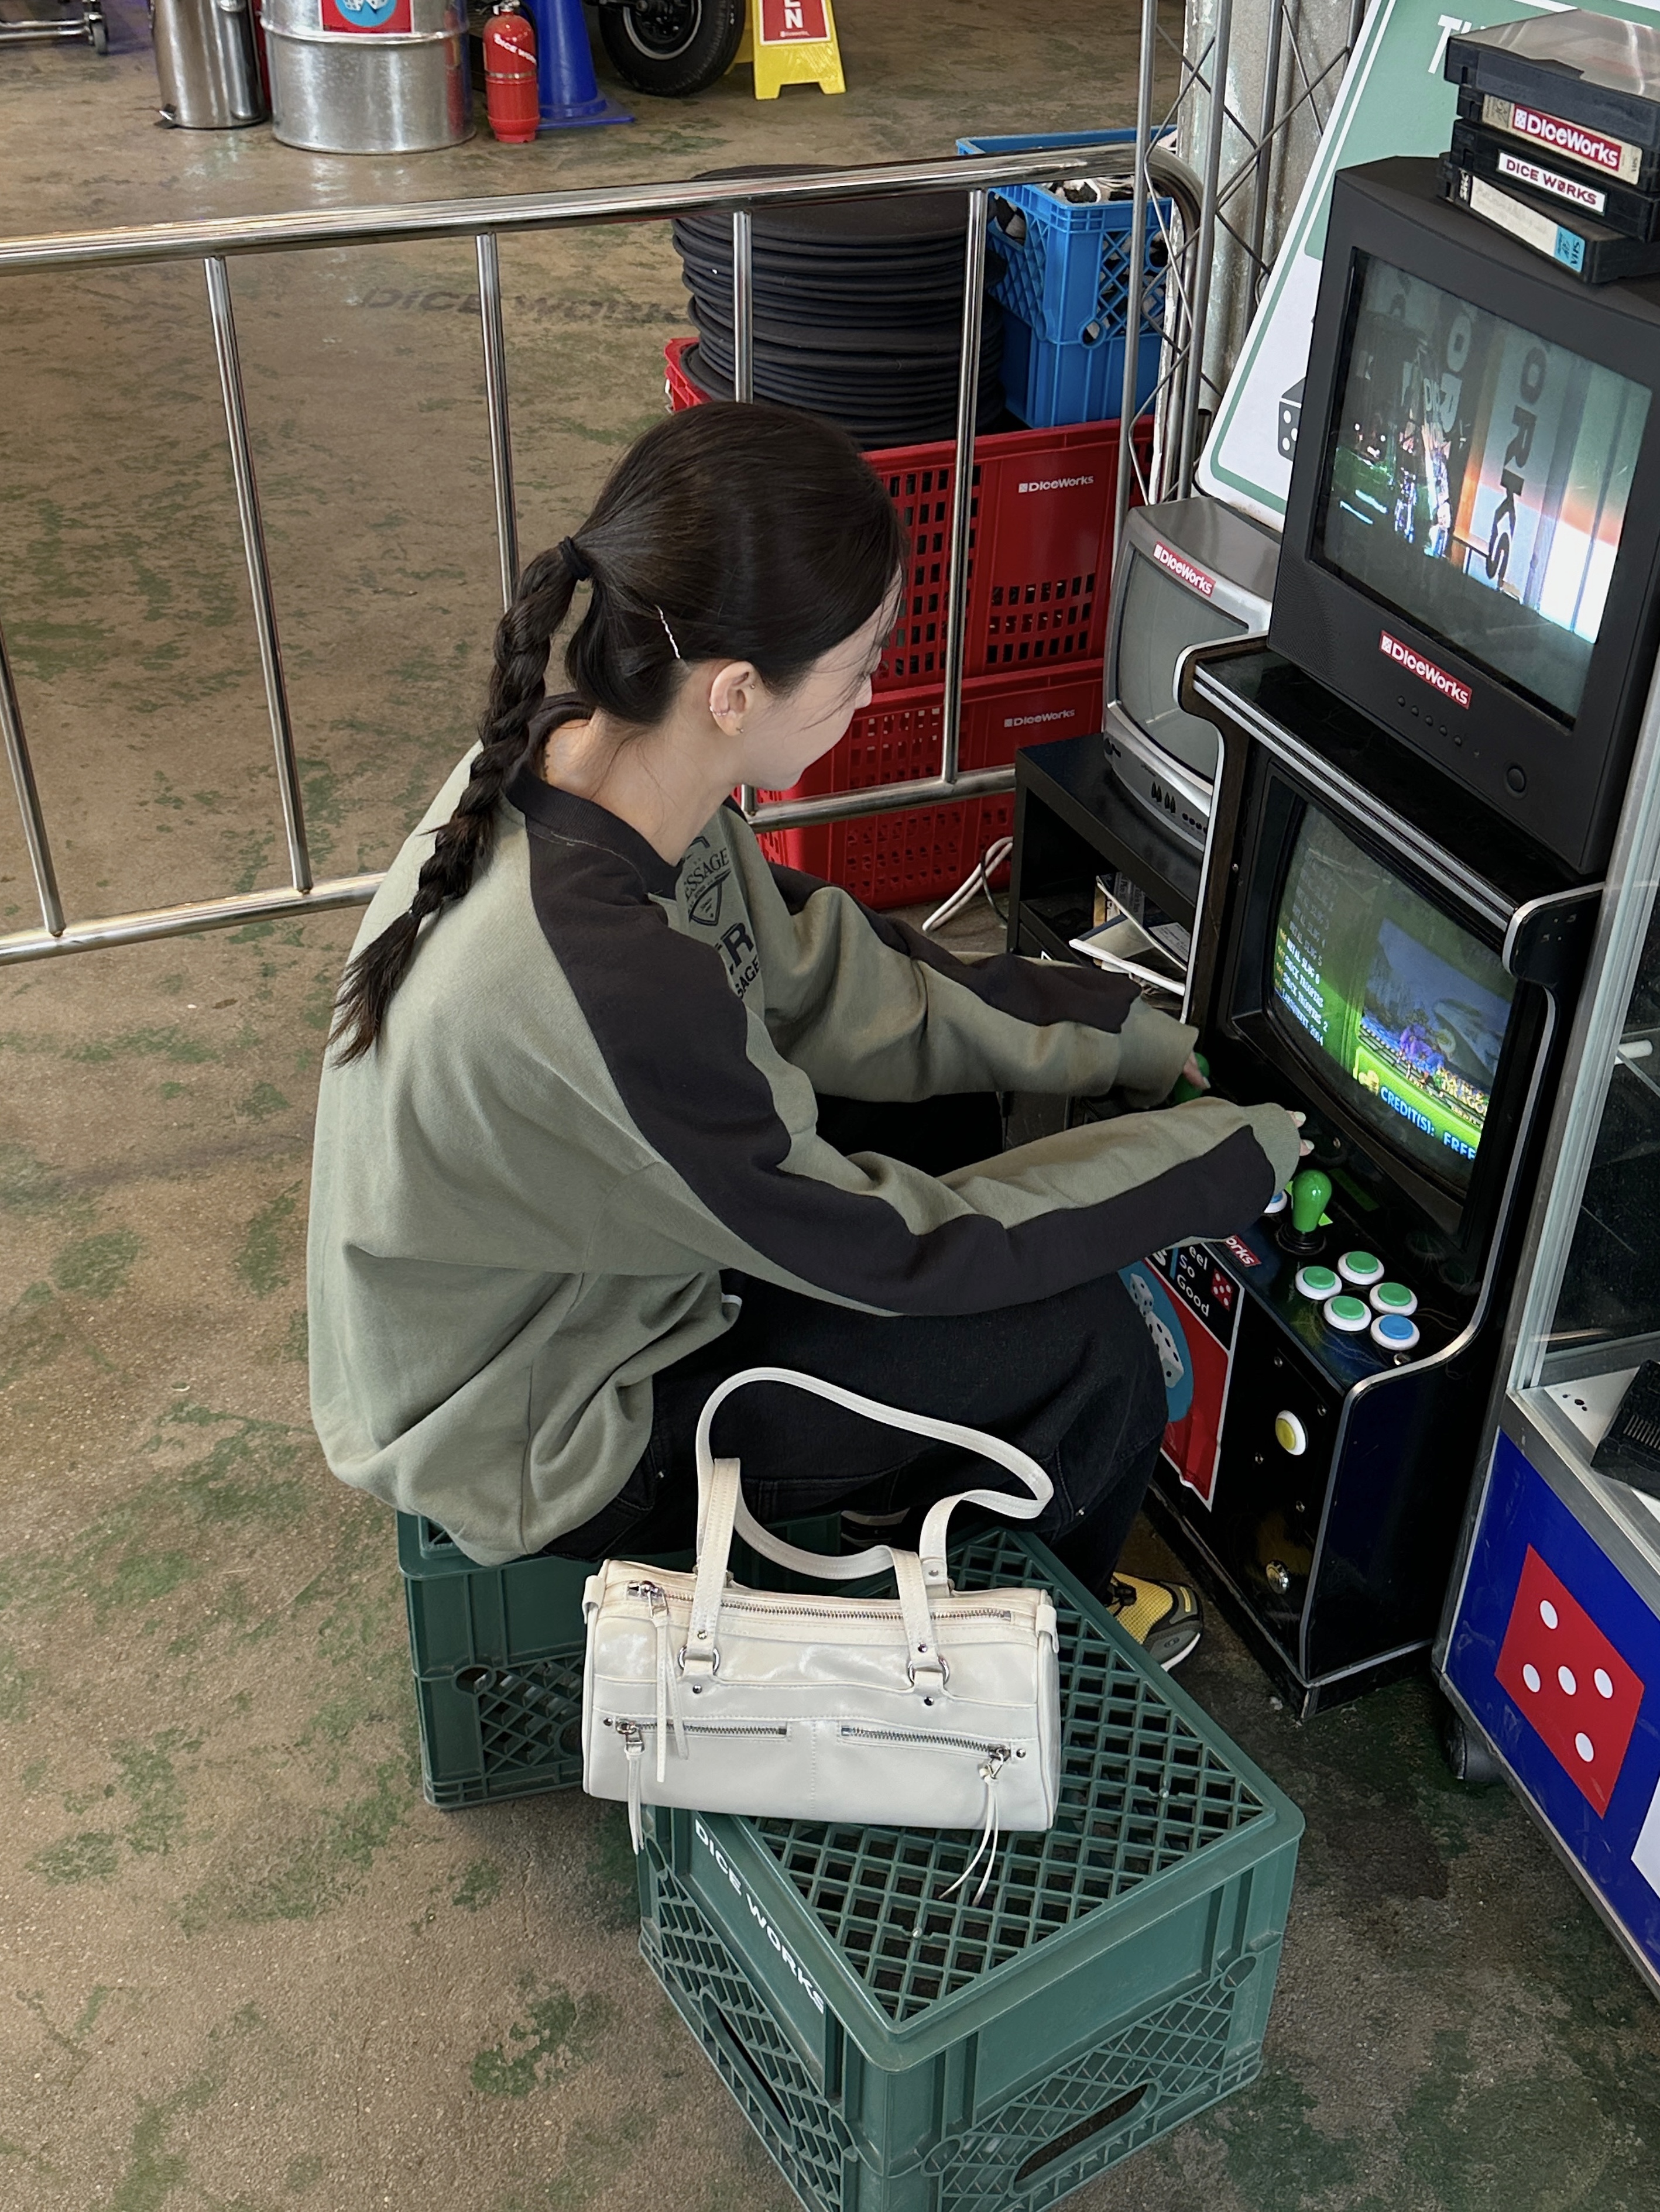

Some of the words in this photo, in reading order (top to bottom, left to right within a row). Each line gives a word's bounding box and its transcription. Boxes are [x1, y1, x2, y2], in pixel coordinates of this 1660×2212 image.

[1505, 159, 1539, 181] DICE
[1484, 345, 1548, 589] ORKS
[1380, 1086, 1436, 1137] CREDIT(S):
[1179, 1253, 1195, 1279] So
[1189, 1245, 1208, 1270] eel
[1226, 1236, 1254, 1265] orks
[1177, 1274, 1210, 1317] Good
[695, 1818, 742, 1896] DICE
[746, 1892, 825, 2015] WORKS
